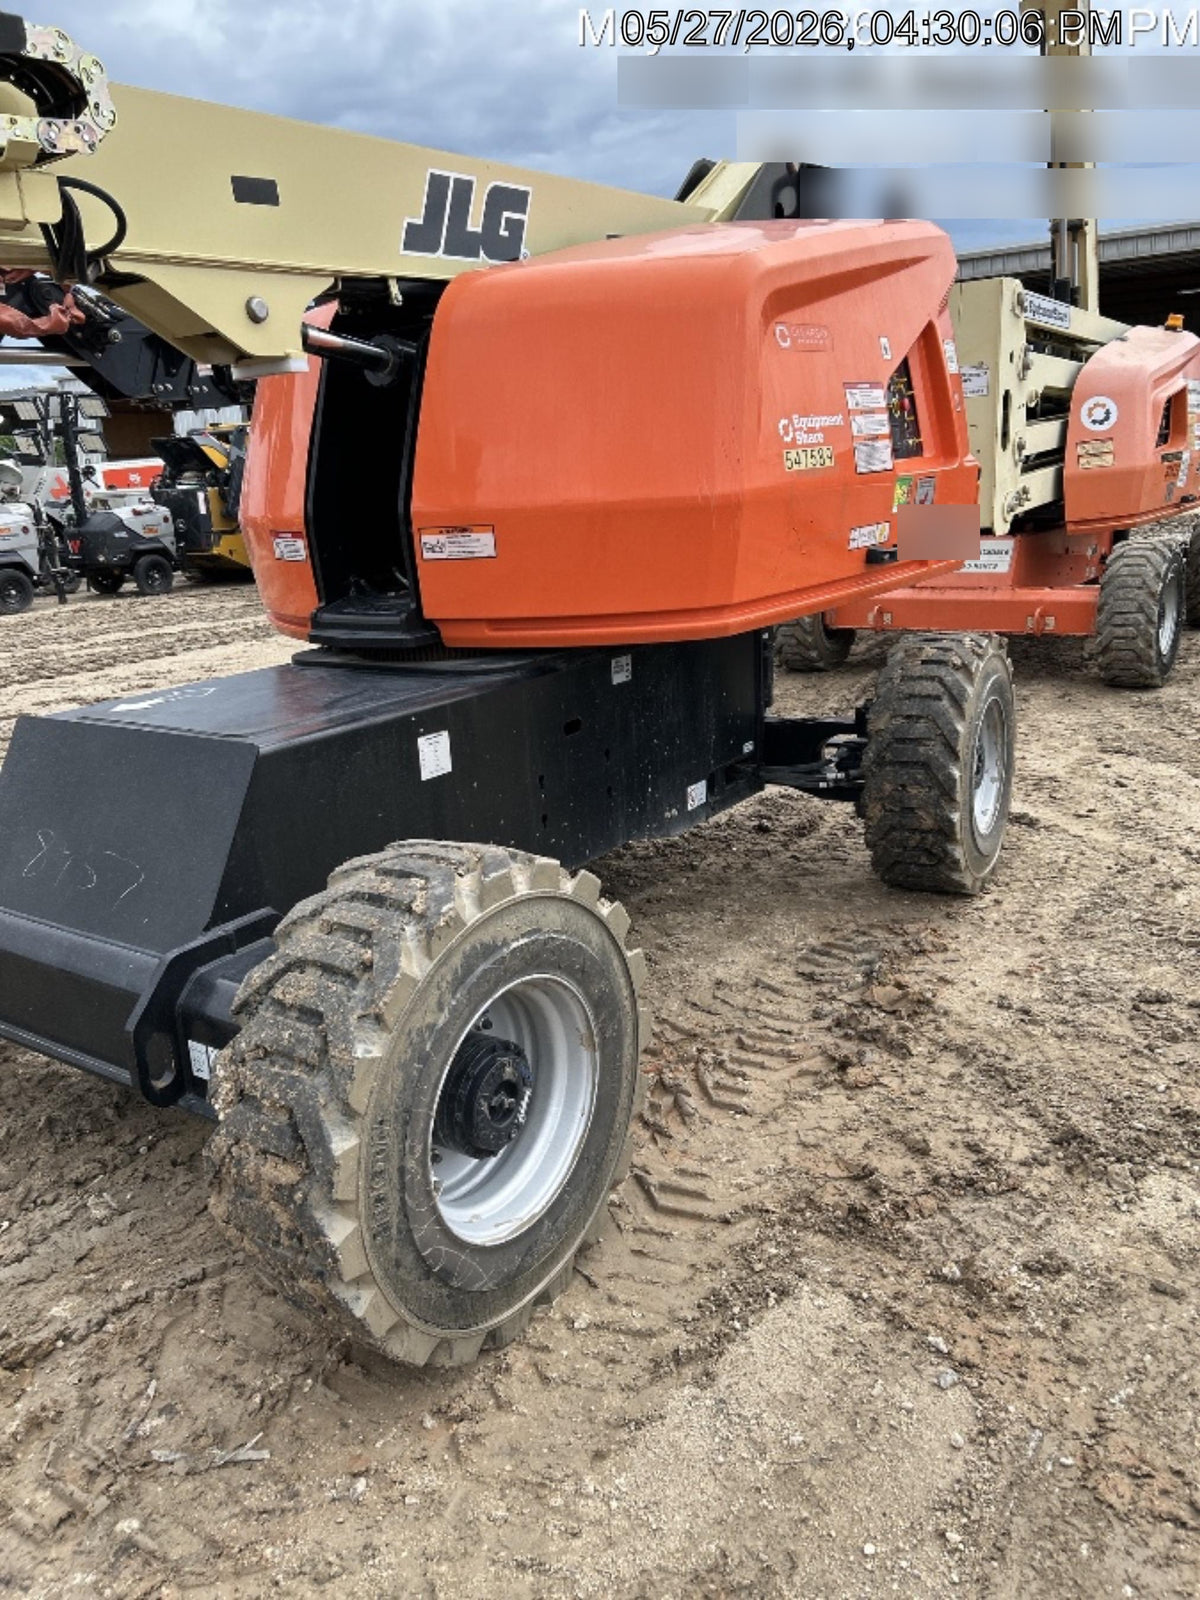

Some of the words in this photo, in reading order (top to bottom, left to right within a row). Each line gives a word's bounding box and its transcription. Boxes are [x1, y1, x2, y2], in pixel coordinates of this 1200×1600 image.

[400, 168, 533, 264] JLG
[793, 413, 844, 431] Equipment
[795, 430, 824, 446] Share
